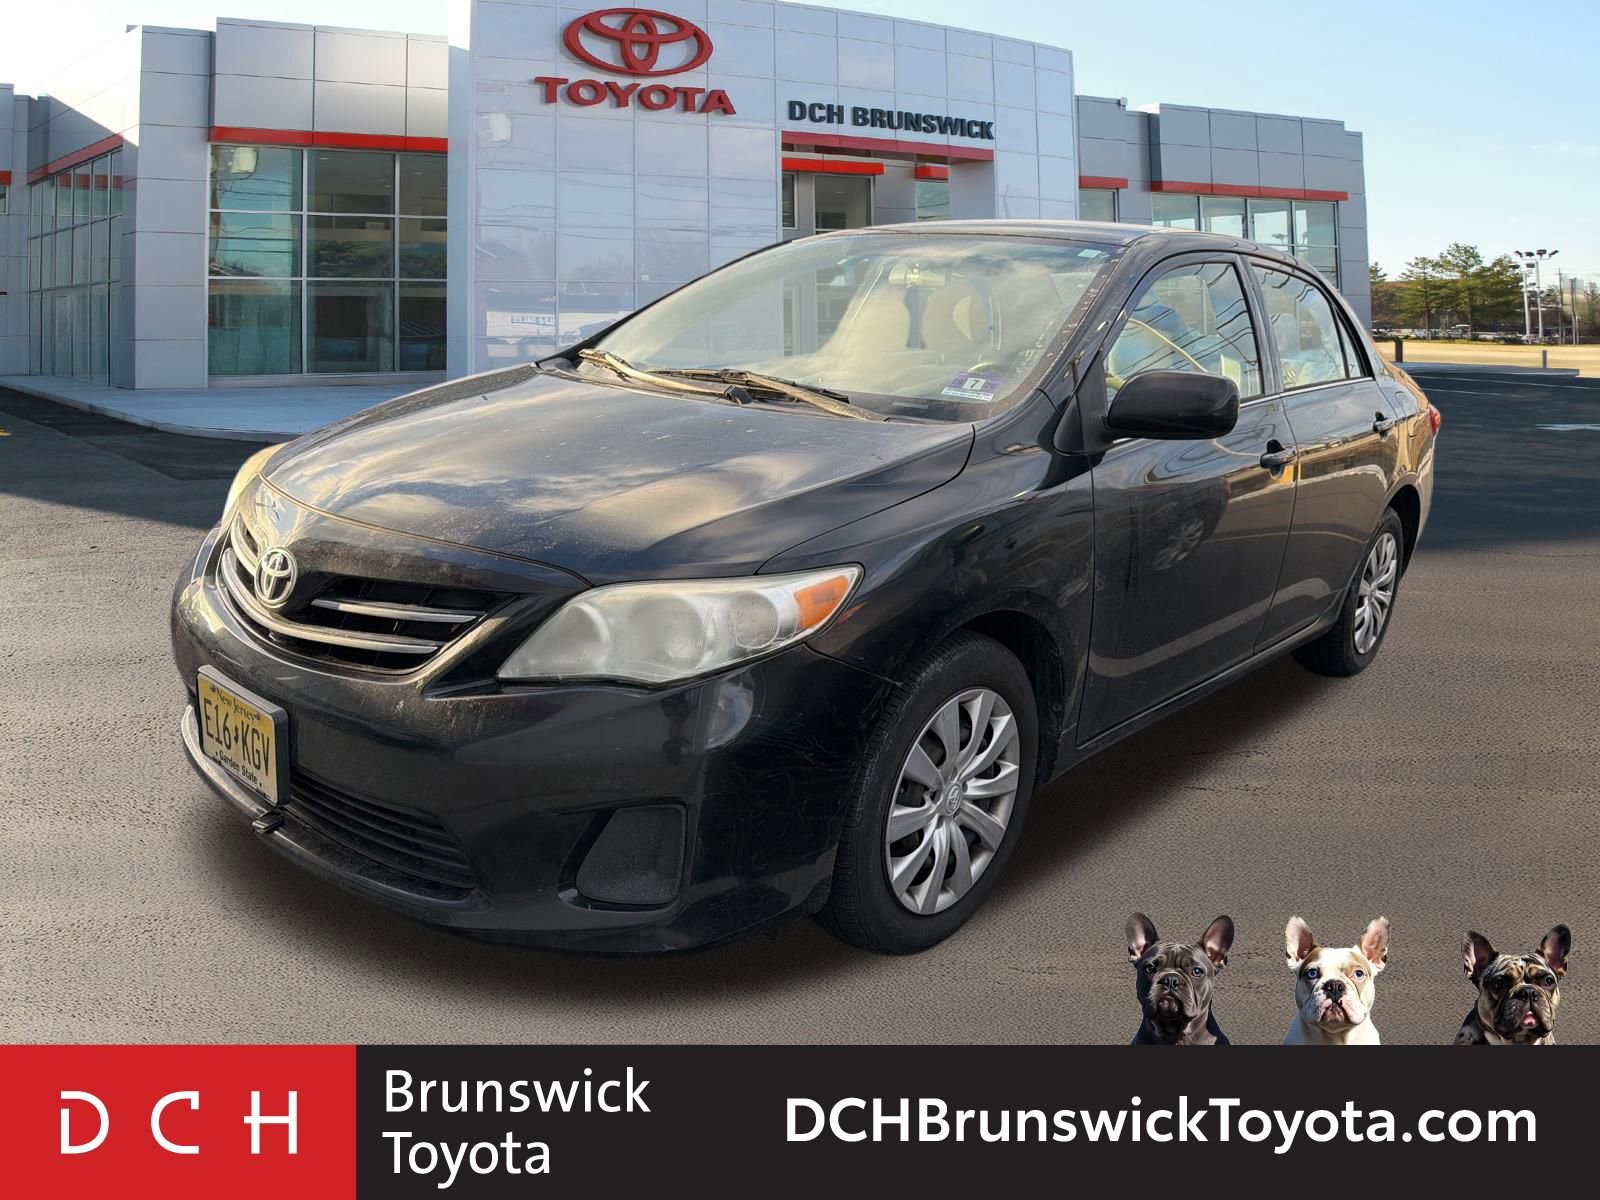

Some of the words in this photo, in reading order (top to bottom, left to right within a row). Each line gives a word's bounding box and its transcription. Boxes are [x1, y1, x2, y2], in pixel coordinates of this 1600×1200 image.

[535, 76, 736, 115] TOYOTA
[788, 100, 844, 125] DCH
[852, 106, 995, 141] BRUNSWICK
[216, 687, 232, 706] New
[232, 697, 257, 726] Jersey
[219, 749, 240, 772] Garden
[241, 763, 258, 785] State
